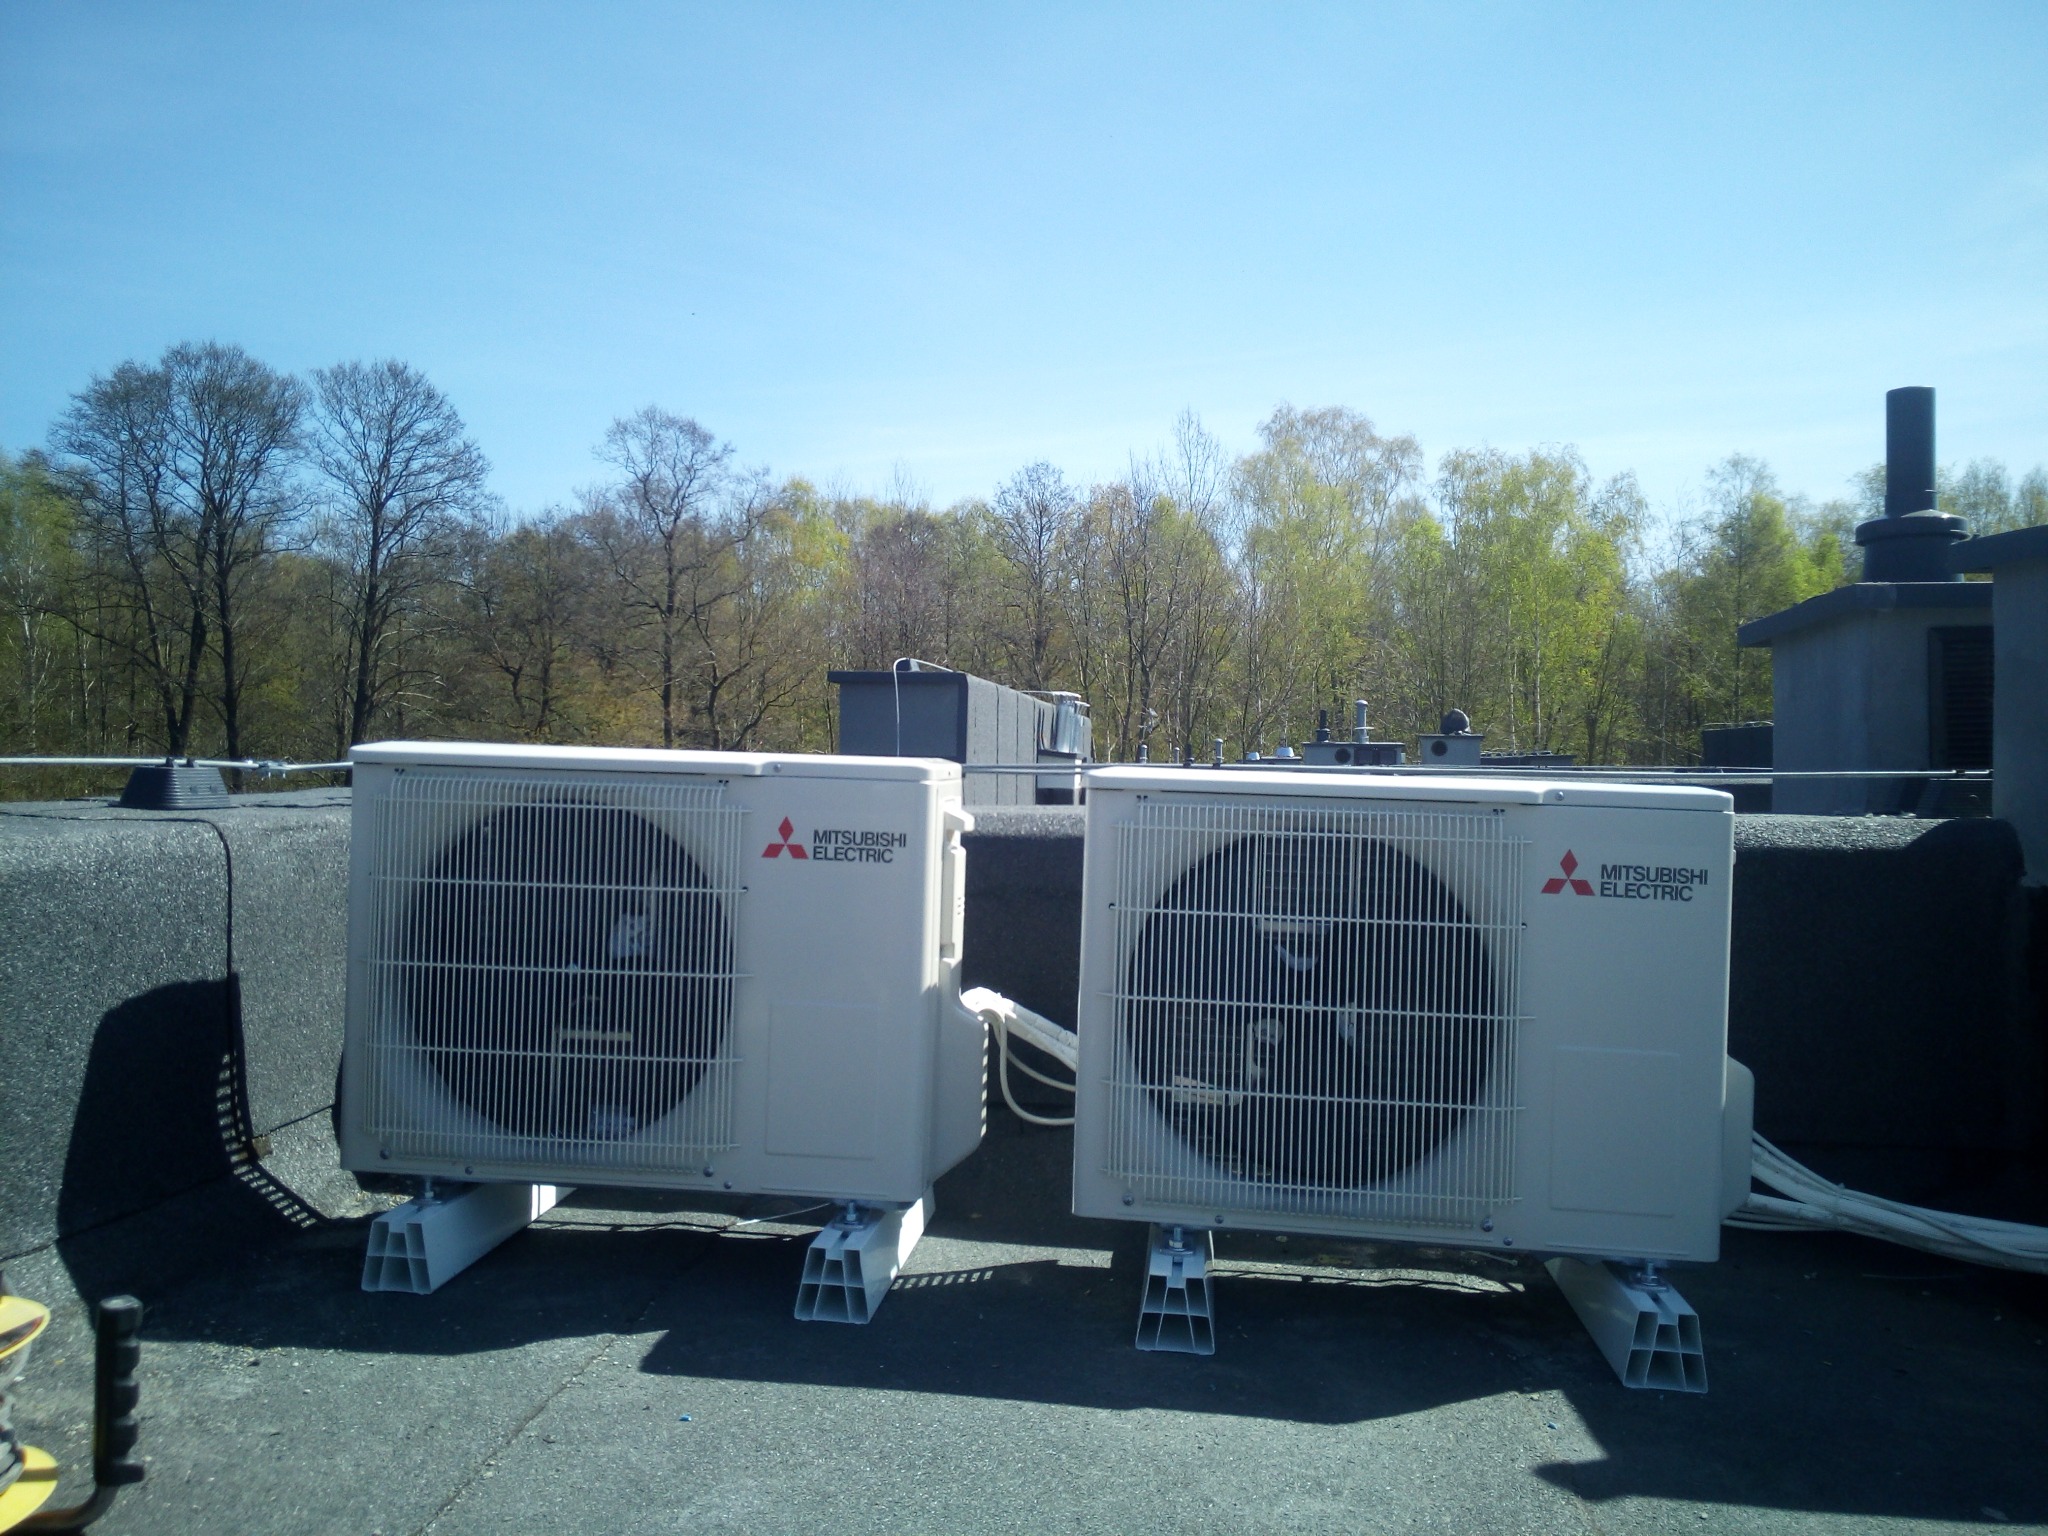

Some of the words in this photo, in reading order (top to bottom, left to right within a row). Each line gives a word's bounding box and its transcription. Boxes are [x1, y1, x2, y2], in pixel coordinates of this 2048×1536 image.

[813, 830, 907, 848] MITSUBISHI
[812, 846, 893, 863] ELECTRIC
[1601, 864, 1709, 885] MITSUBISHI
[1600, 882, 1693, 902] ELECTRIC
